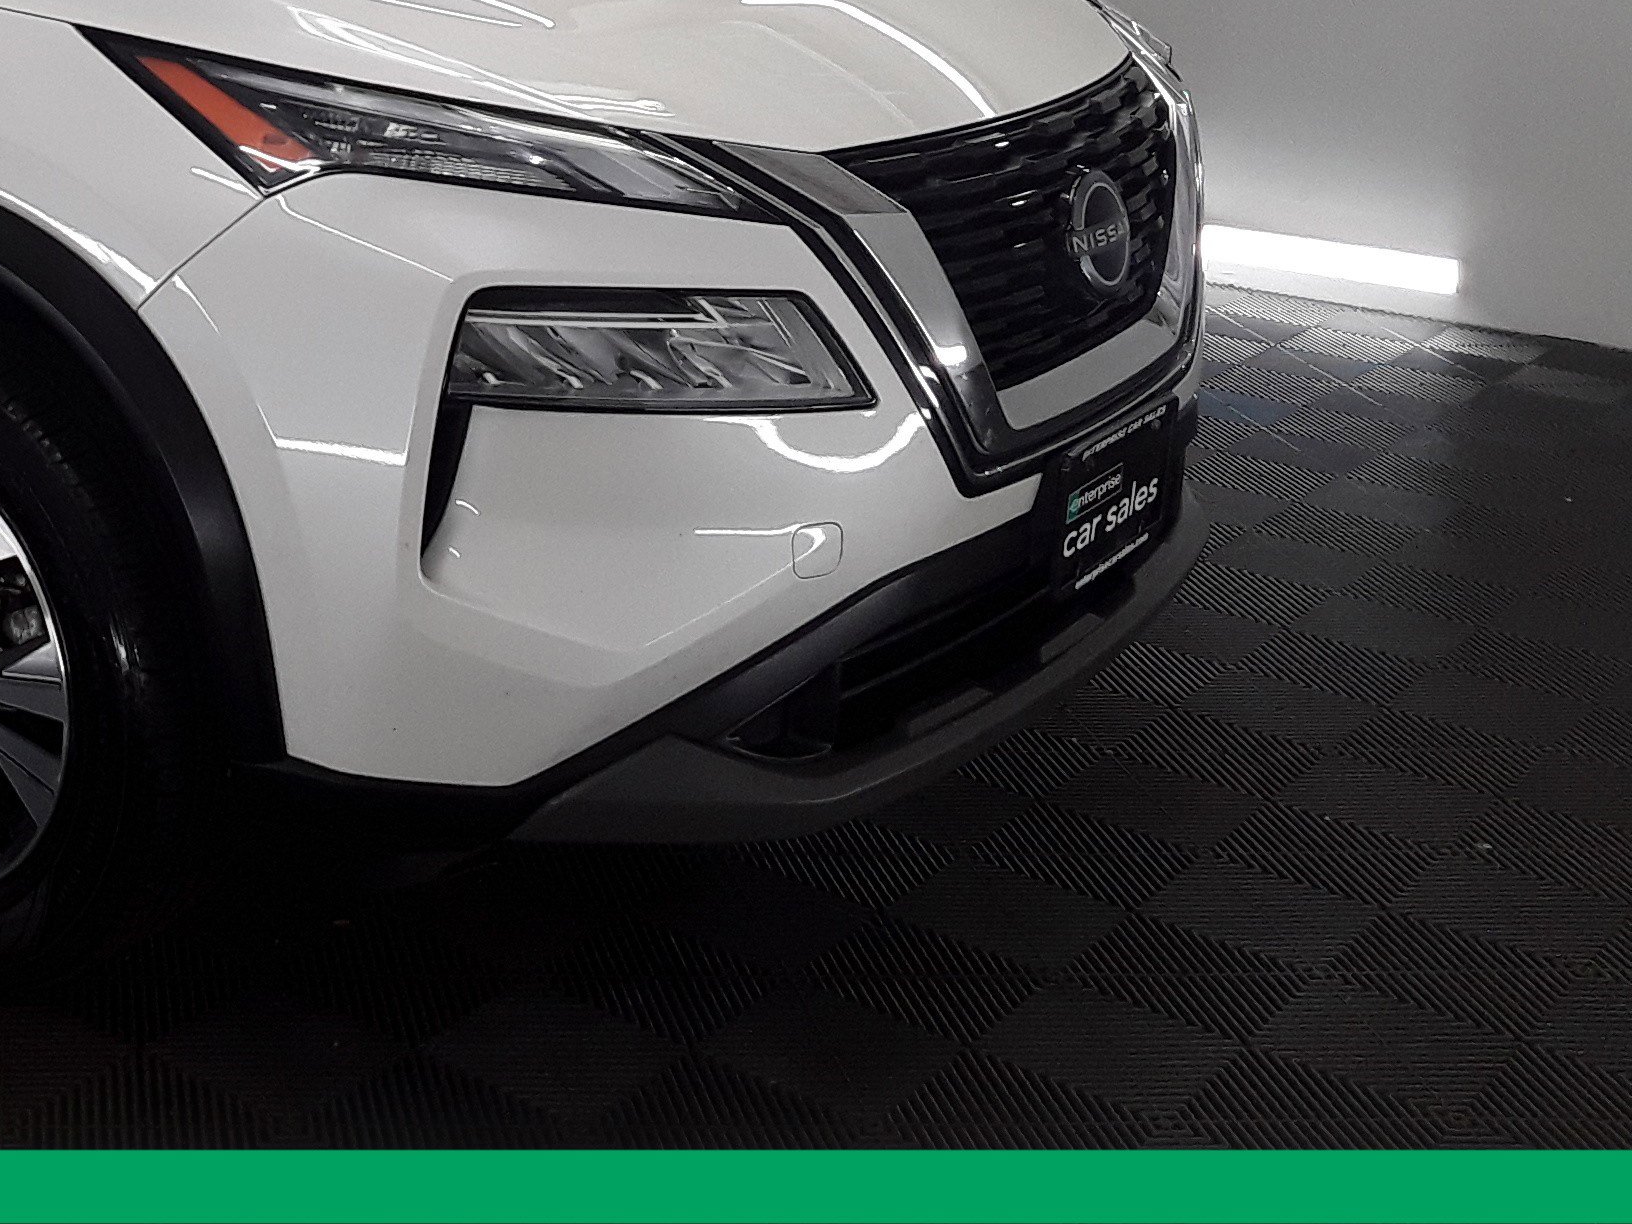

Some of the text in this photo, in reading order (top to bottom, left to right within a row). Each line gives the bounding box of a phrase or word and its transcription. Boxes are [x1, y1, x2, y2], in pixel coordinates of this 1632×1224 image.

[1064, 478, 1158, 557] car sales
[1069, 473, 1122, 514] enterprise
